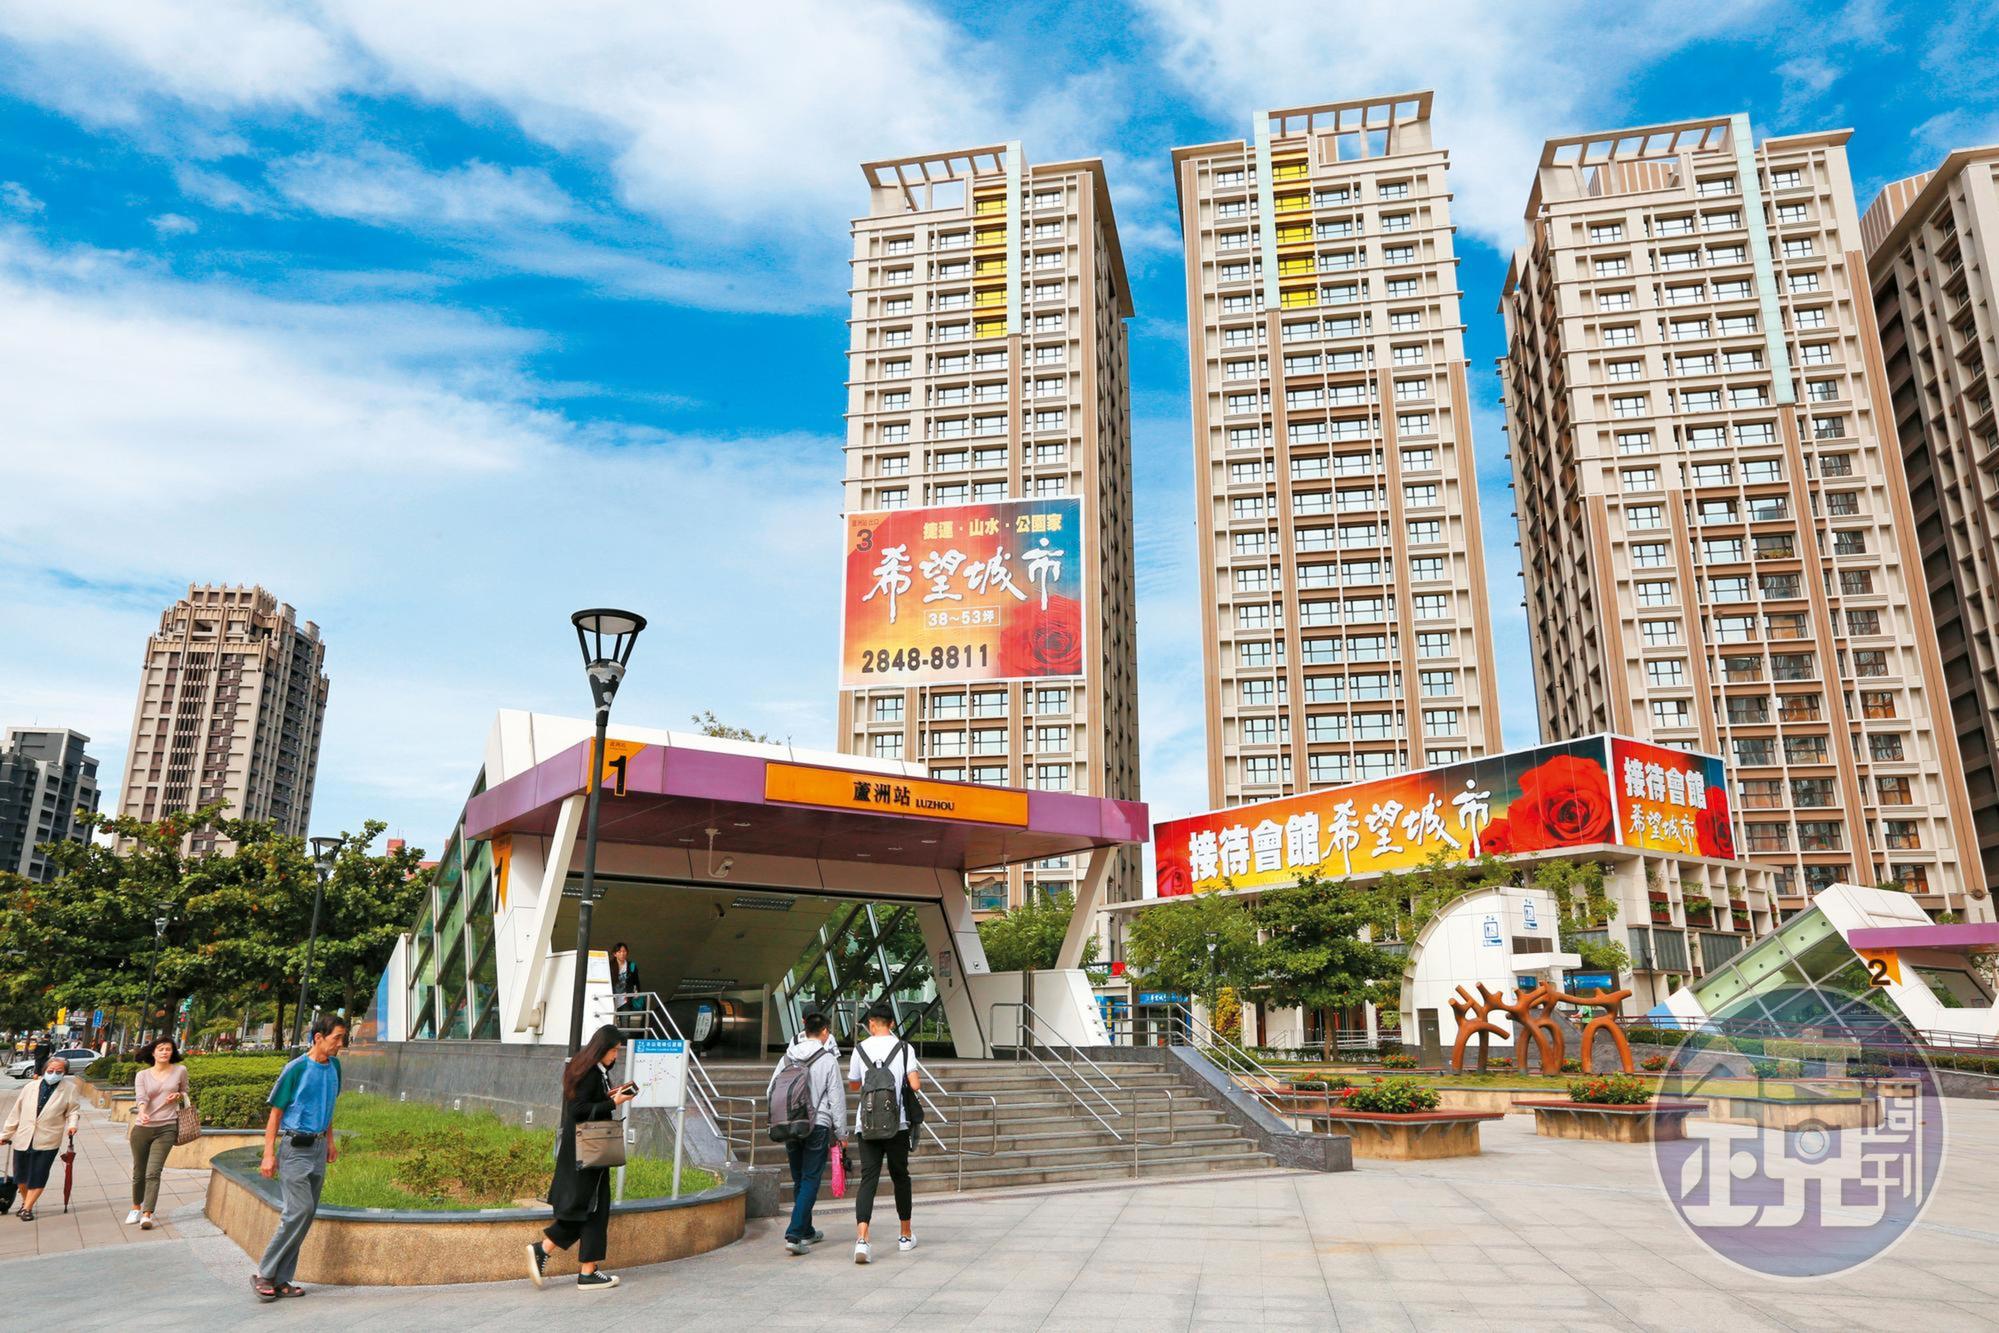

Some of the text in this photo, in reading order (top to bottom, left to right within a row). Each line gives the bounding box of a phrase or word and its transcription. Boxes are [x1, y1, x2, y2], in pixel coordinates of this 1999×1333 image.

[856, 528, 873, 551] 3
[862, 537, 1065, 624] 希望城市
[861, 643, 988, 673] 2848-8811
[608, 754, 627, 796] 1
[853, 780, 956, 811] 蘆洲站 LUZHOU
[1623, 755, 1708, 810] 接待會館
[1188, 779, 1493, 883] 接待會館 希望城市
[1628, 803, 1695, 853] 希望城市
[1867, 958, 1892, 987] 2
